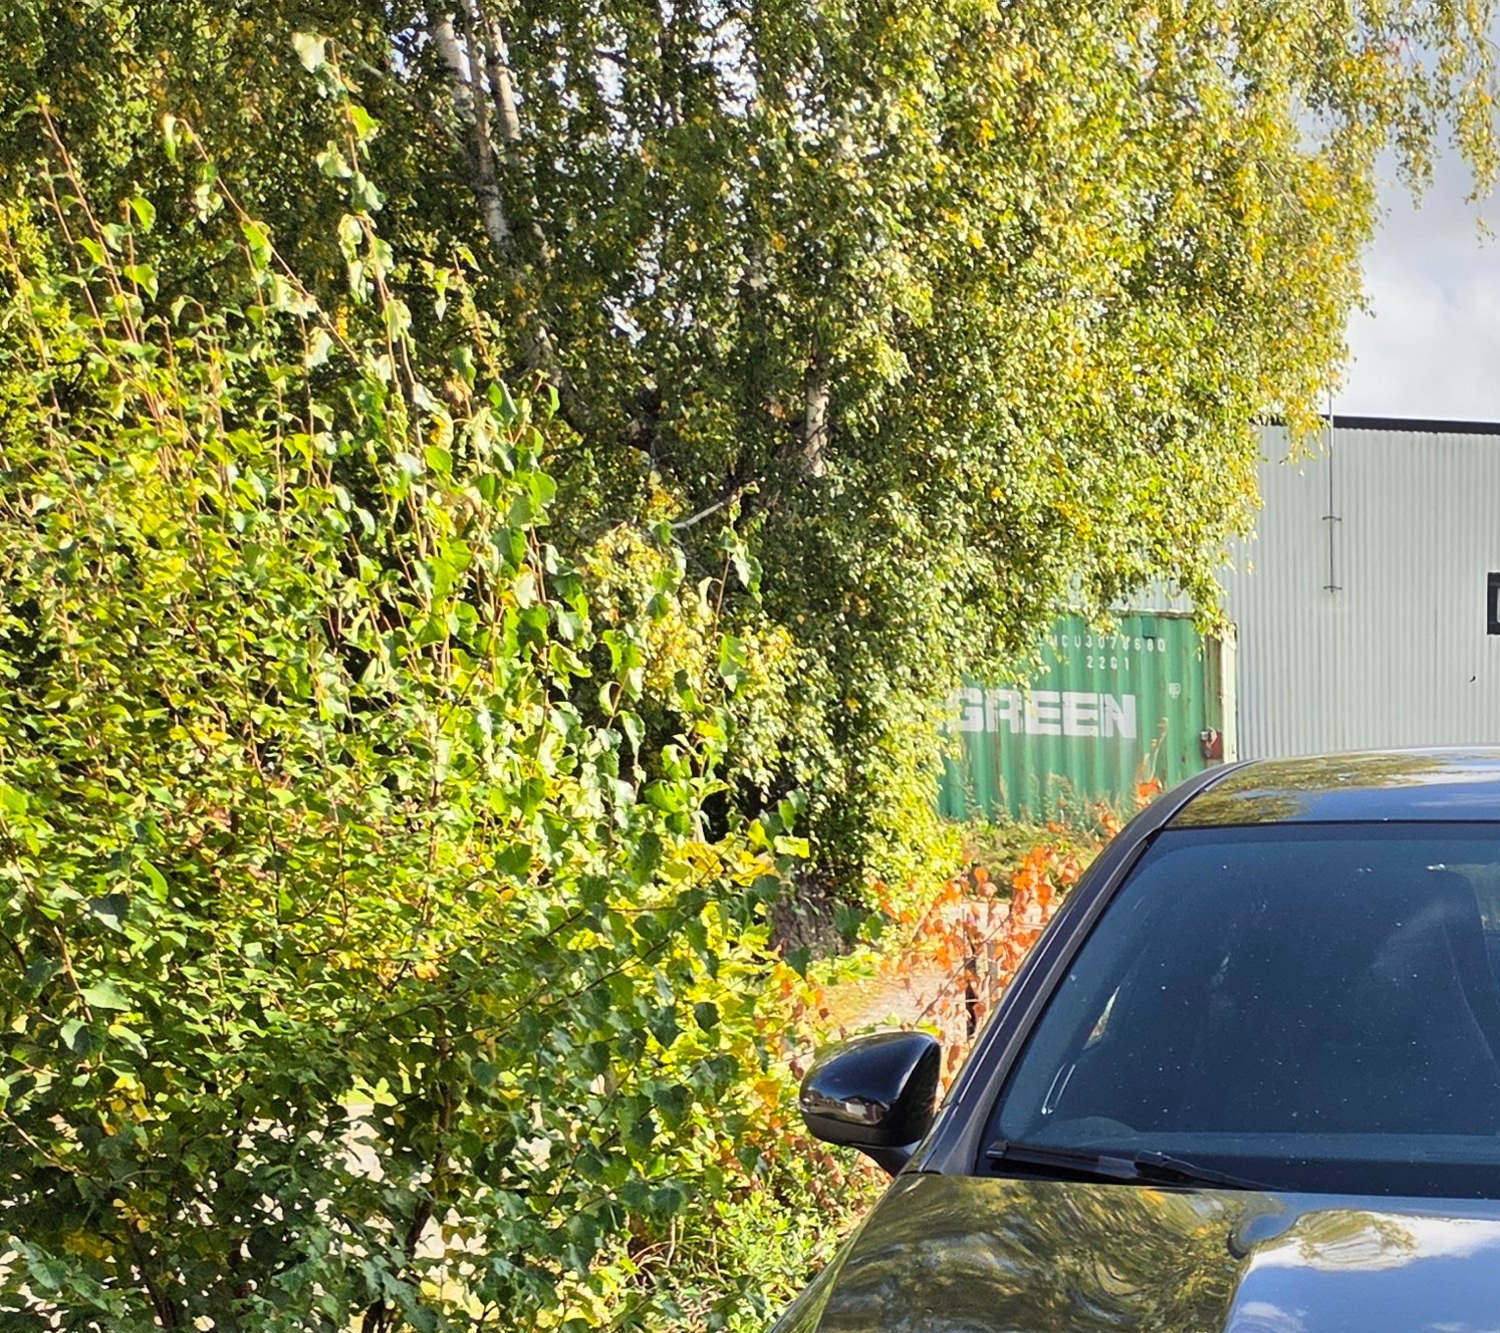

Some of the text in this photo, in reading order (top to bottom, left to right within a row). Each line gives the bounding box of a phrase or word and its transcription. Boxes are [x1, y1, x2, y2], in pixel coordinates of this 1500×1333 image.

[1037, 634, 1166, 652] CU3078680
[1086, 655, 1130, 671] 22G1
[941, 687, 1136, 739] GREEN
